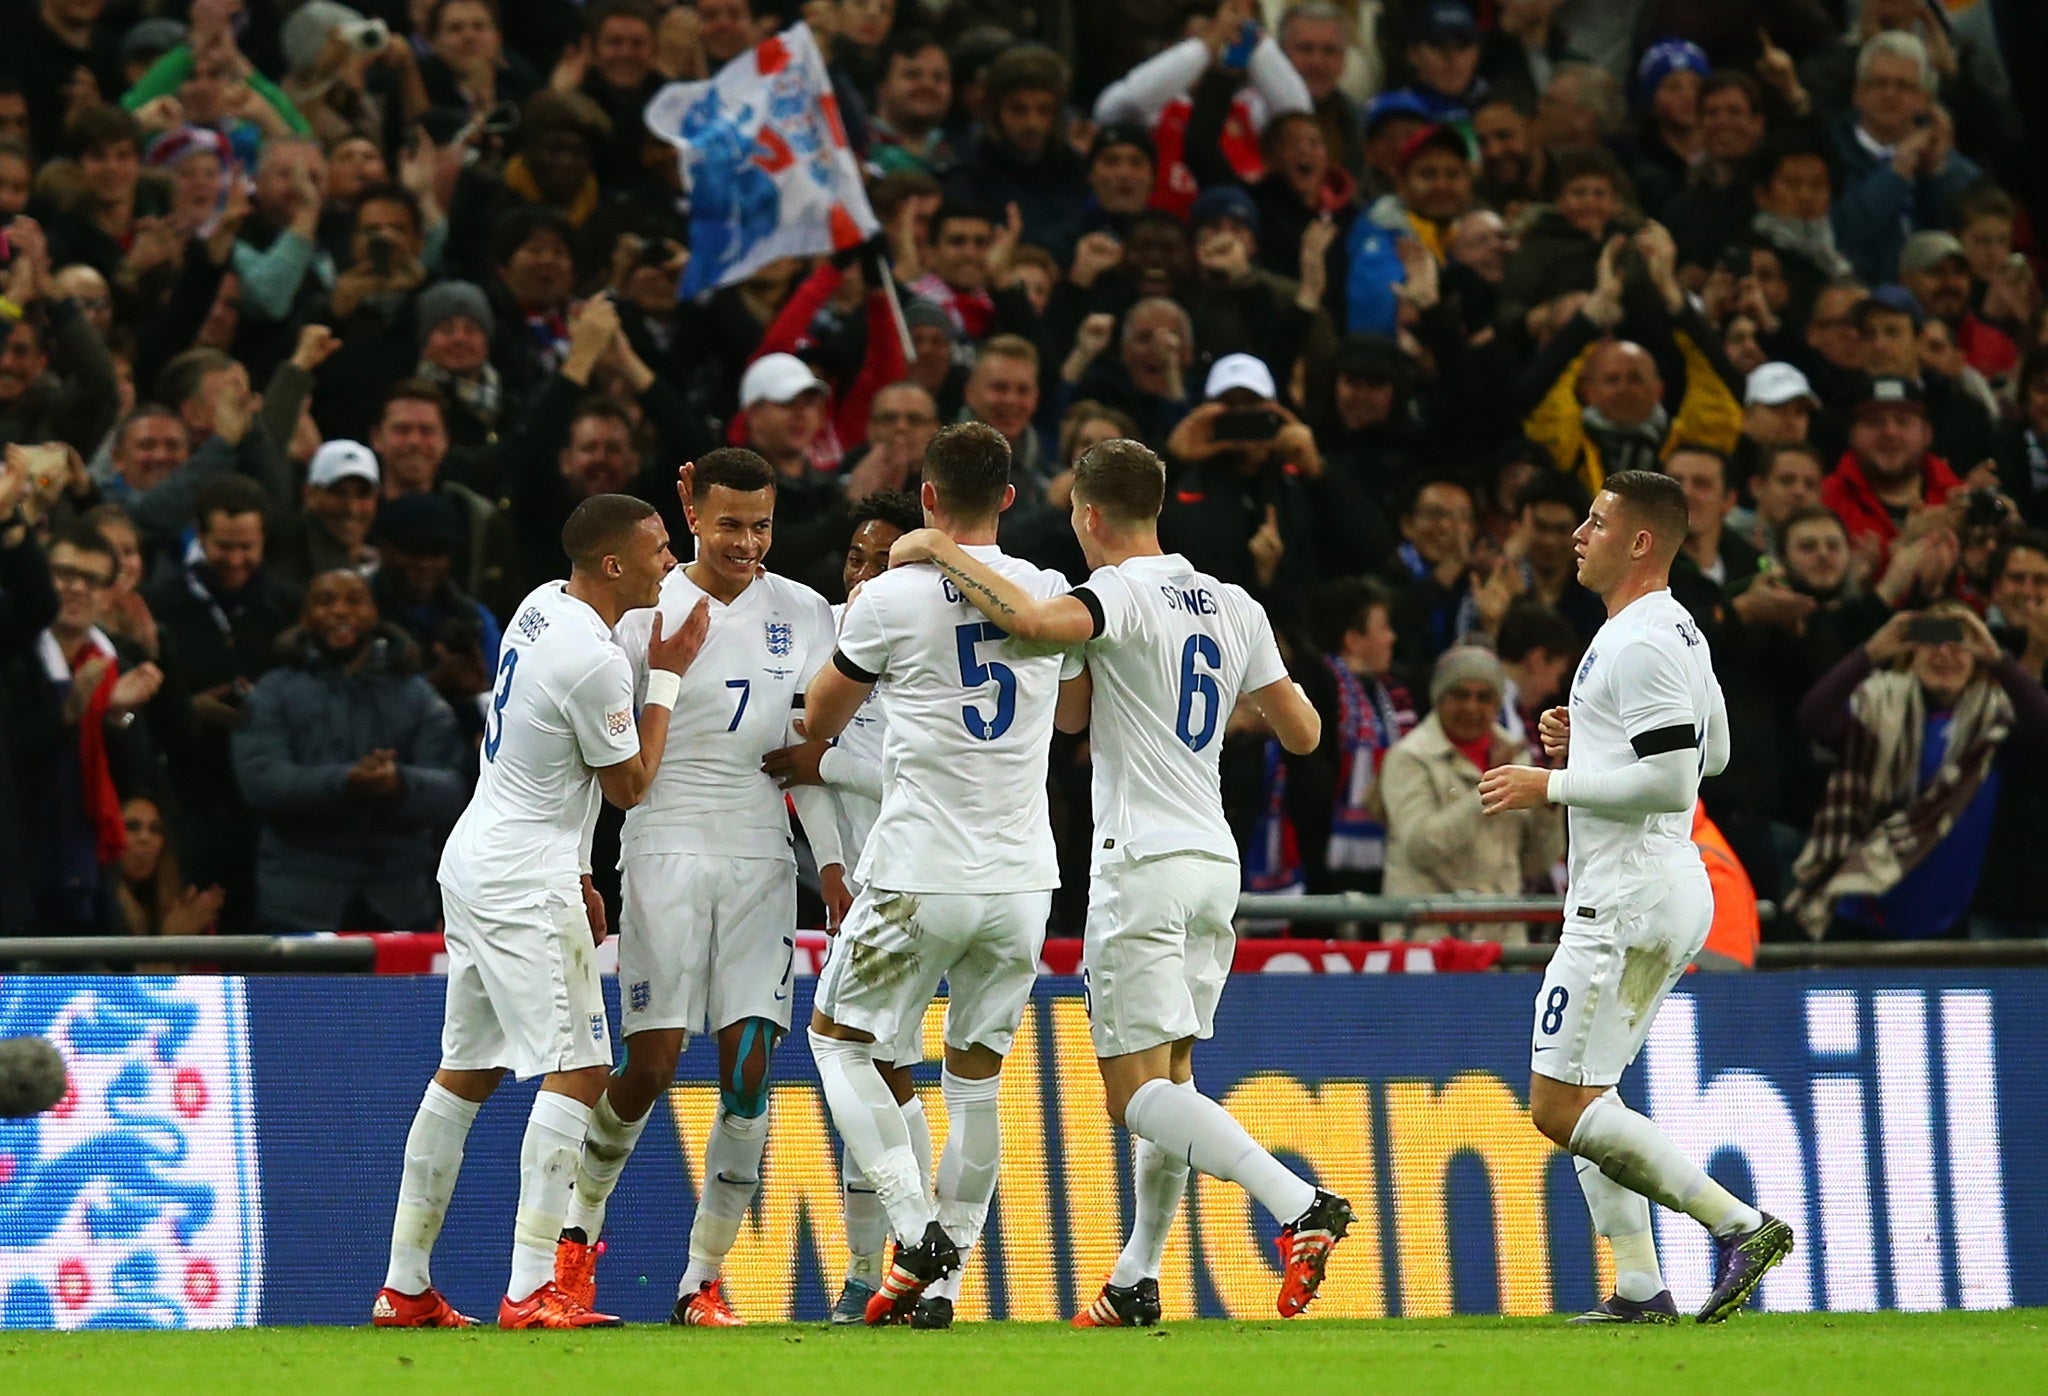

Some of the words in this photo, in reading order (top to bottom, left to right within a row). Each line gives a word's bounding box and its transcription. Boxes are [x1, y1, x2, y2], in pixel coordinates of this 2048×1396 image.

[485, 647, 519, 763] 3
[725, 679, 750, 731] 7
[955, 621, 1017, 741] 5
[1176, 633, 1221, 752] 6
[783, 935, 794, 986] 7
[1541, 985, 1569, 1035] 8
[667, 990, 1618, 1321] willam
[1643, 987, 2014, 1314] hill
